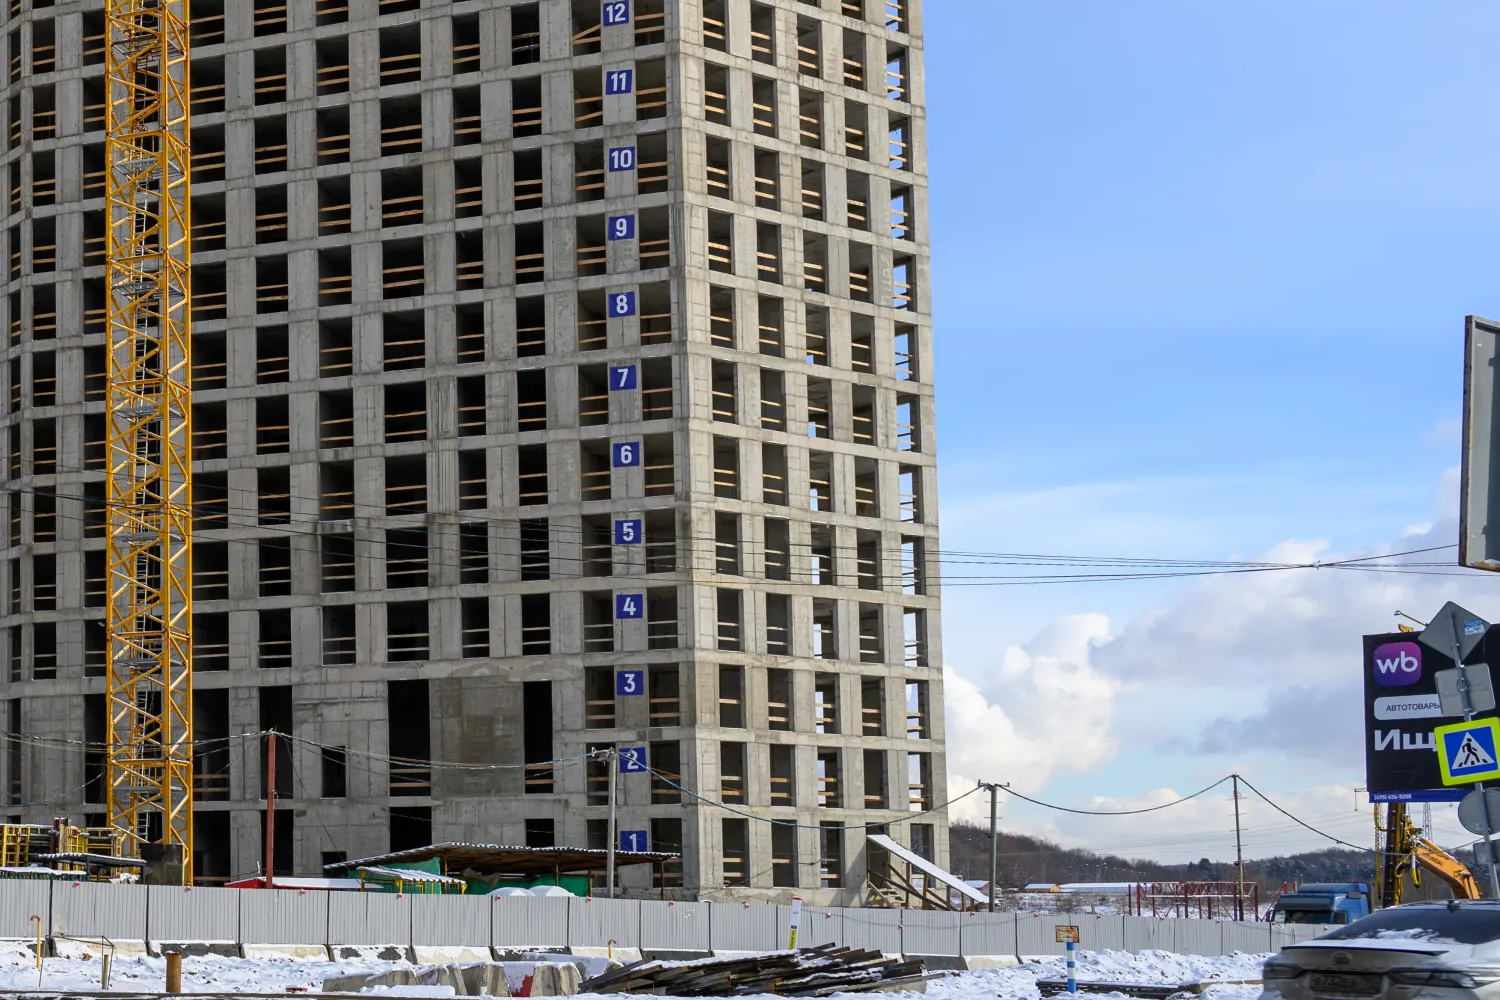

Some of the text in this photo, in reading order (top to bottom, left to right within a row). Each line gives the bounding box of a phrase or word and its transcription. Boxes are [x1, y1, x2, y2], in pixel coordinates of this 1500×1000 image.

[607, 4, 626, 22] 12
[611, 73, 627, 91] 11
[612, 150, 631, 168] 10
[616, 219, 627, 236] 9
[616, 295, 627, 313] 8
[618, 369, 629, 387] 7
[621, 446, 632, 463] 6
[623, 523, 634, 541] 5
[624, 598, 636, 615] 4
[1376, 651, 1419, 674] wb
[625, 674, 636, 692] 3
[626, 750, 638, 770] 2
[629, 834, 638, 852] 1
